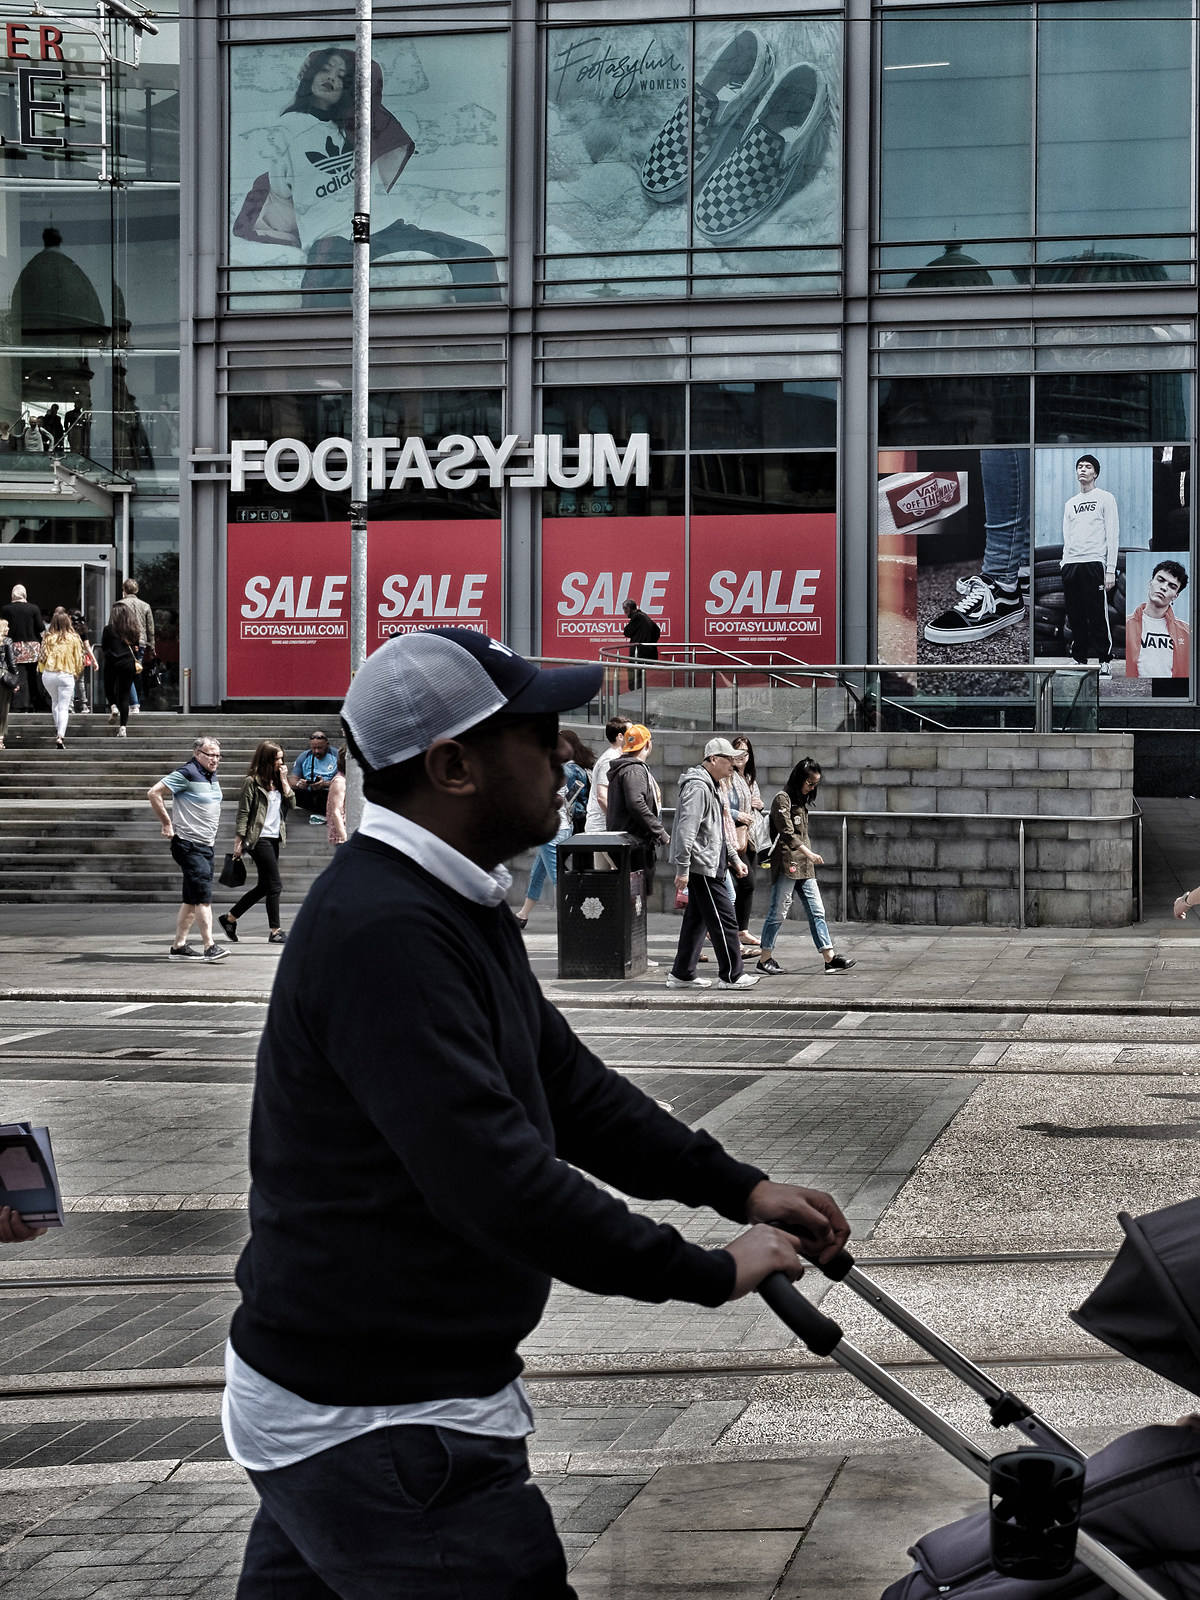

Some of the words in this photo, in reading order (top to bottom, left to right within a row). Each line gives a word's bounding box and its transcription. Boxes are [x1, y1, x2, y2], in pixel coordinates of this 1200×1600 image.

[640, 78, 687, 91] WOMENS
[315, 168, 355, 198] adid
[231, 433, 649, 492] FOOTASYLUM
[1073, 501, 1098, 514] VANS
[241, 575, 348, 619] SALE
[378, 574, 488, 618] SALE
[557, 571, 671, 616] SALE
[705, 569, 821, 615] SALE
[244, 624, 344, 636] FOOTASYLUM.COM
[709, 621, 817, 632] FOOTASYLUM.COM
[1141, 632, 1174, 650] VANS
